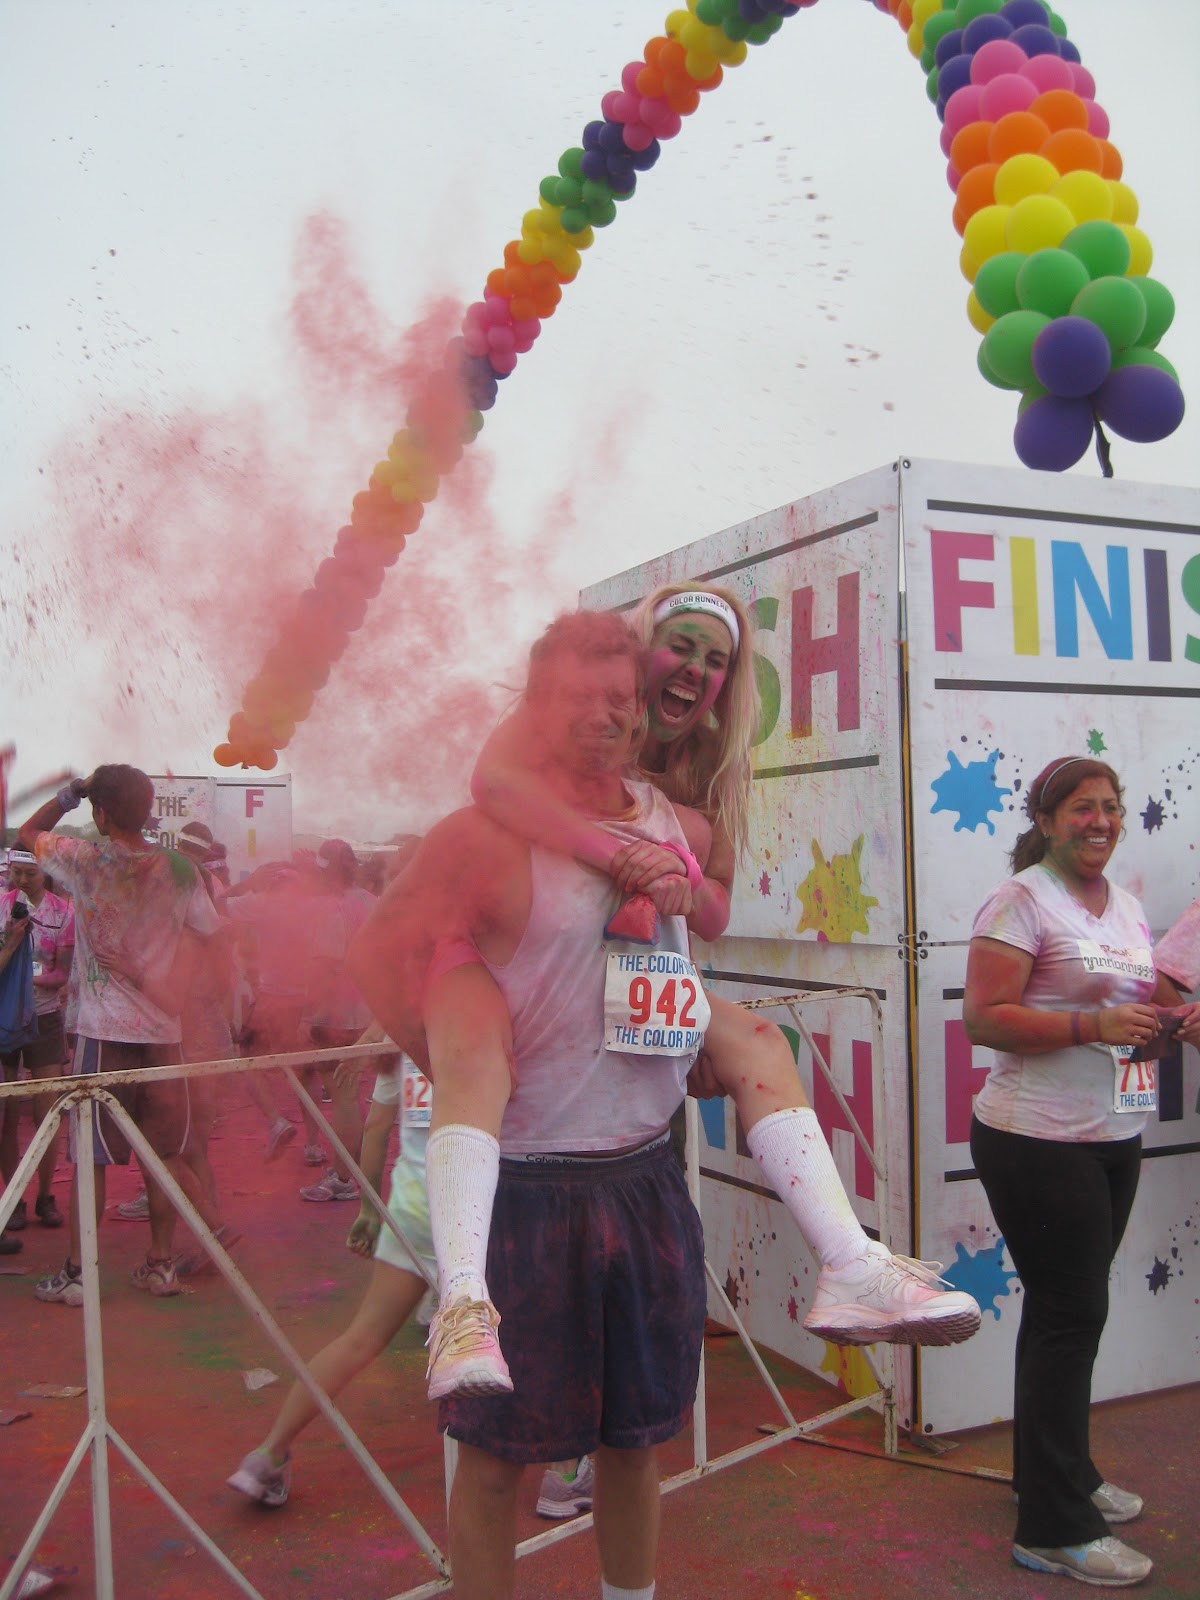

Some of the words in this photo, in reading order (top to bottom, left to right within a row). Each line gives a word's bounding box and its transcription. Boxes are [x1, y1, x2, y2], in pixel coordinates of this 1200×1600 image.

[669, 595, 694, 608] COLOR
[155, 796, 188, 817] THE
[618, 954, 645, 972] THE
[647, 954, 685, 975] COLOR
[628, 976, 697, 1028] 942
[615, 1025, 640, 1045] THE
[643, 1028, 683, 1048] COLOR
[1119, 1094, 1136, 1107] THE
[525, 1153, 560, 1165] Calvin
